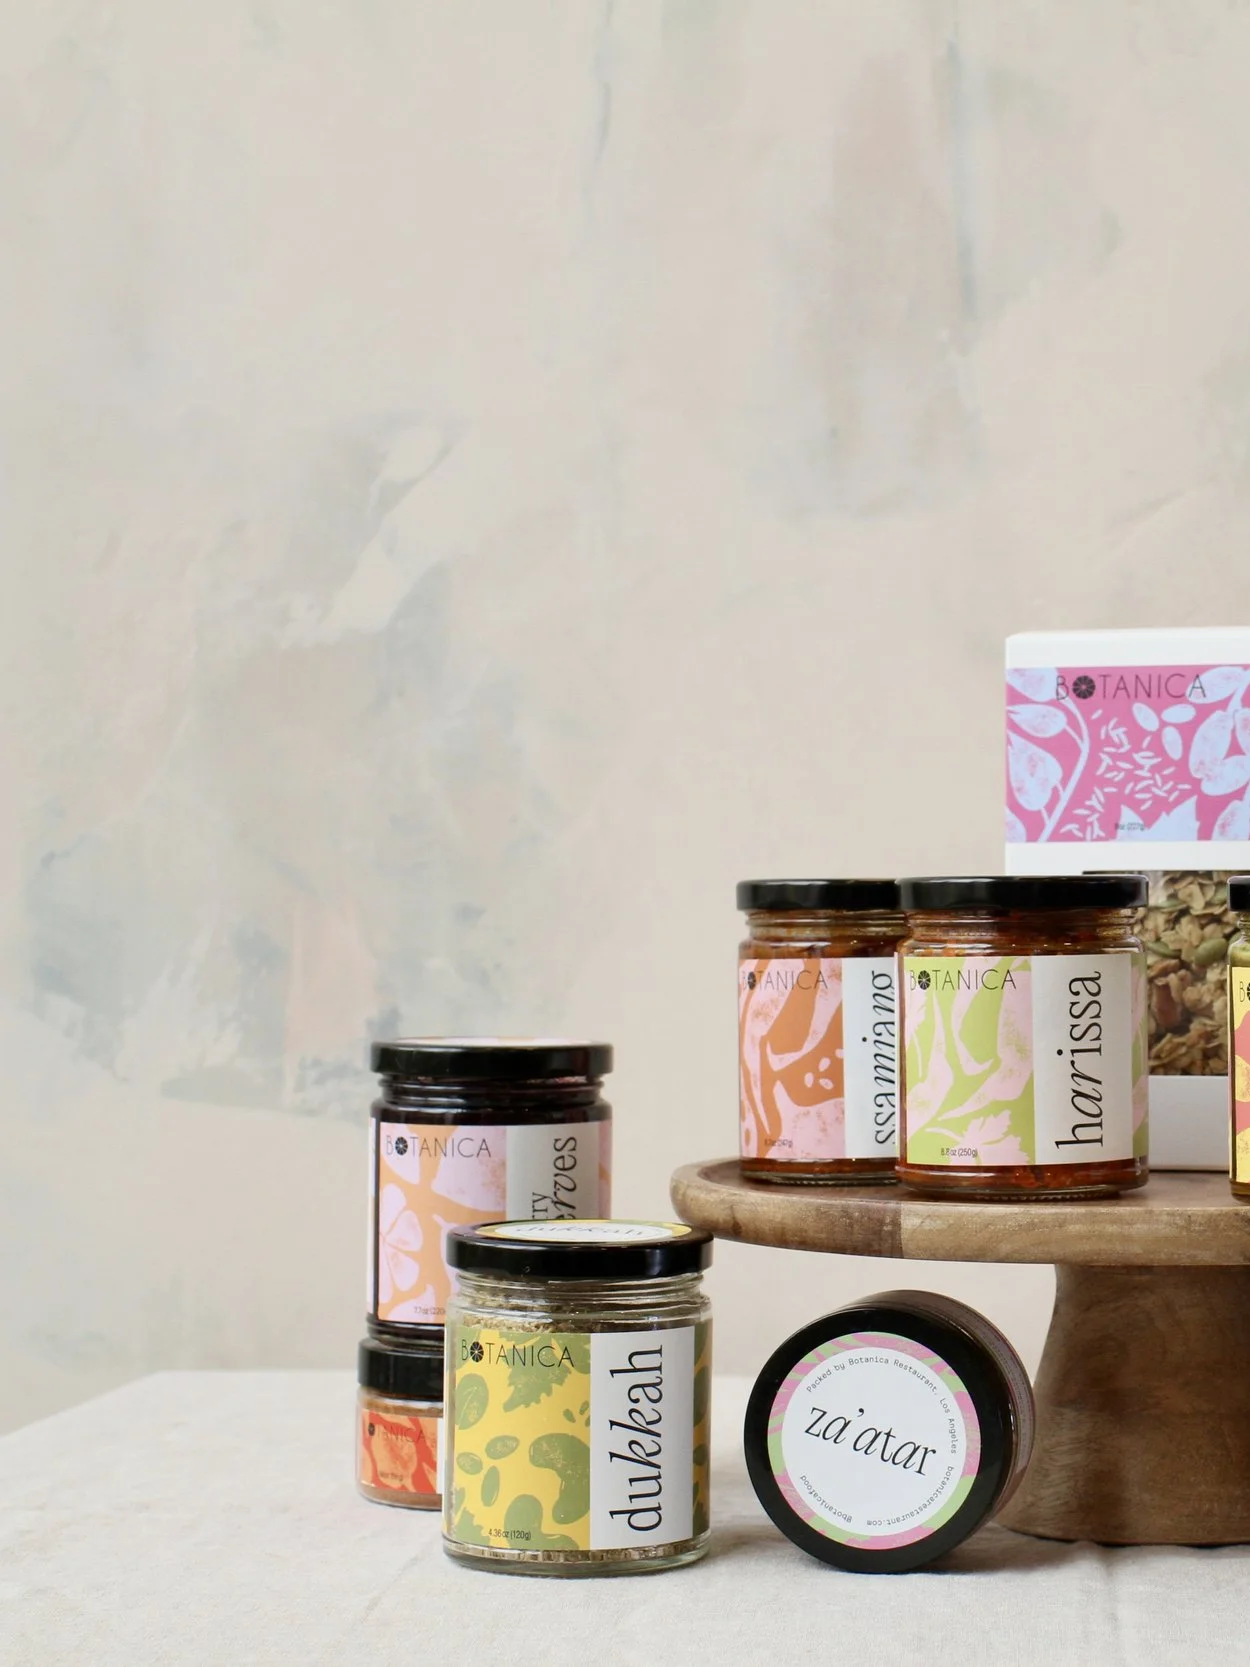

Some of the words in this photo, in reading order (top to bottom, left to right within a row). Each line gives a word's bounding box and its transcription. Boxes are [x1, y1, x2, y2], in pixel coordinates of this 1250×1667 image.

[1055, 673, 1207, 701] BOTANICA
[909, 968, 1017, 991] BOTANICA
[1054, 970, 1103, 1149] harissa
[386, 1134, 492, 1159] BOTANICA
[461, 1338, 575, 1368] BOTANICA
[806, 1368, 833, 1393] Packed
[833, 1361, 846, 1374] by
[847, 1355, 890, 1367] Botanica
[940, 1397, 951, 1414] Los
[948, 1418, 959, 1455] Angeles
[609, 1344, 663, 1531] dukkah
[804, 1406, 937, 1476] za'atar
